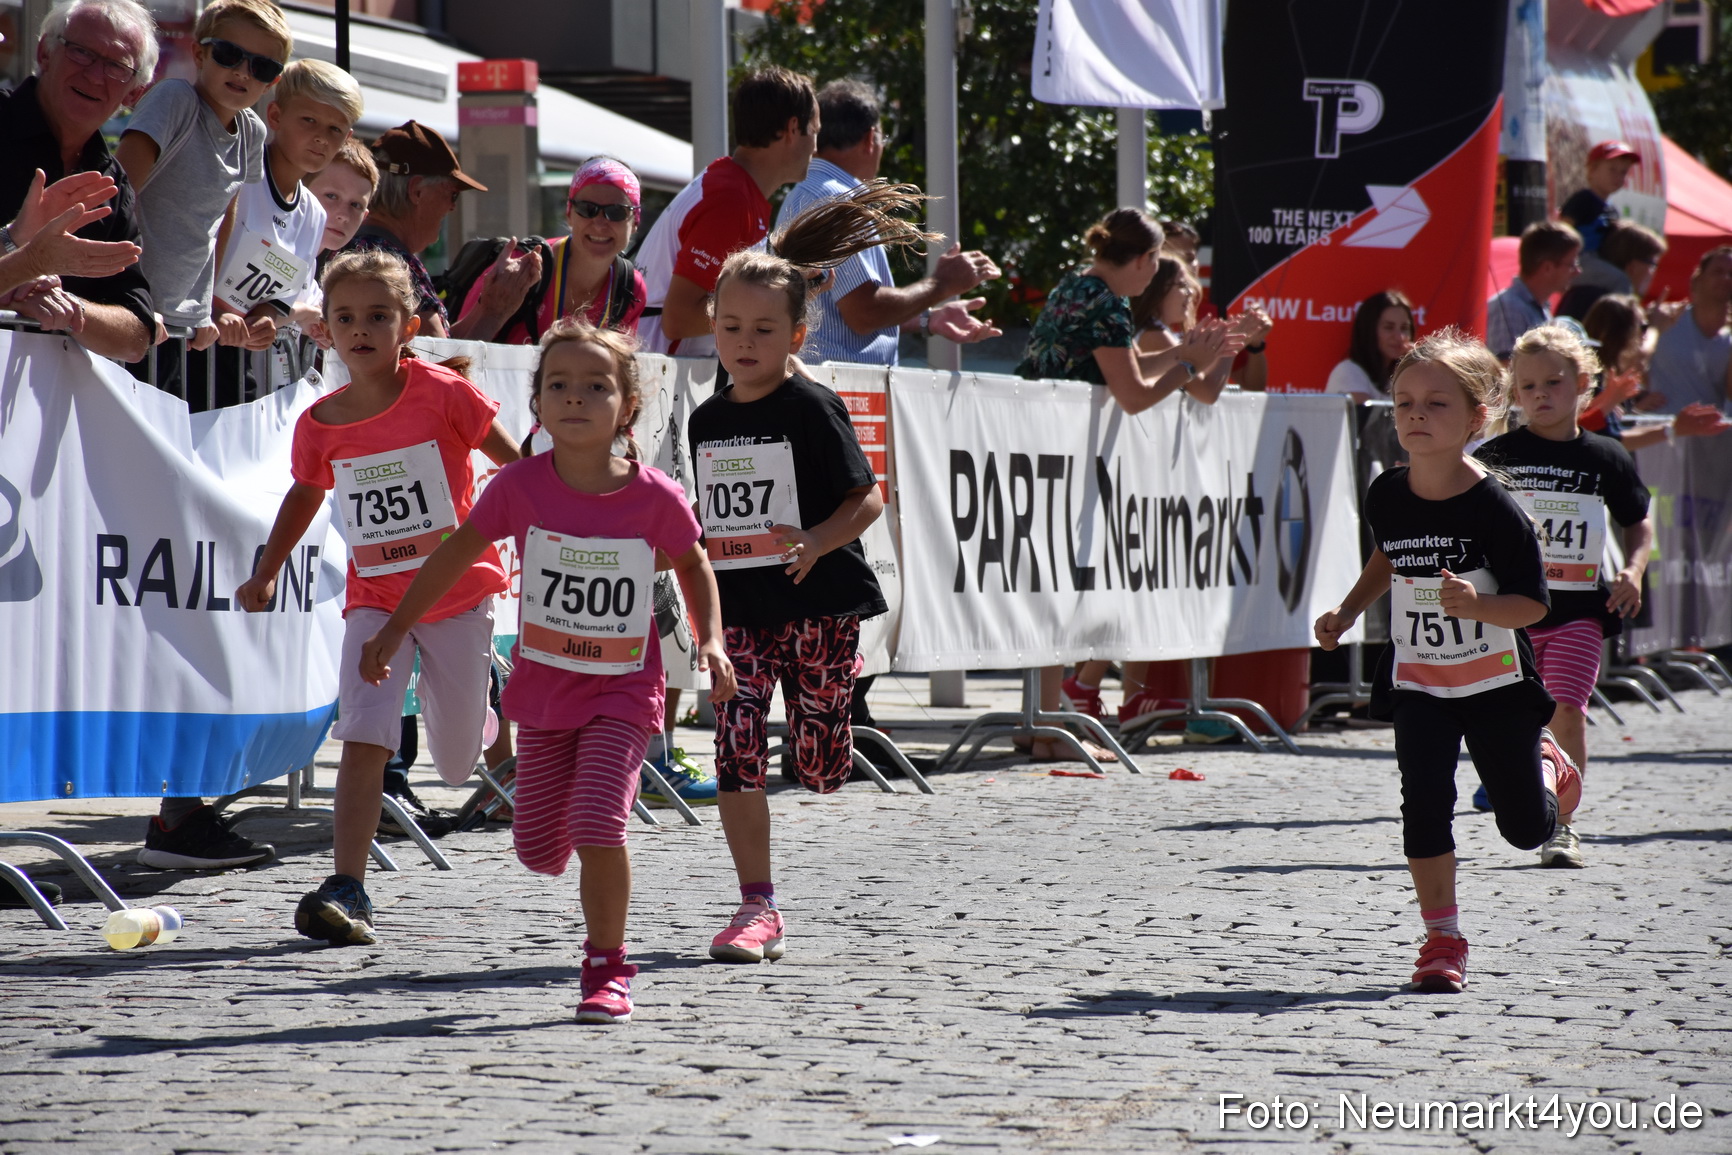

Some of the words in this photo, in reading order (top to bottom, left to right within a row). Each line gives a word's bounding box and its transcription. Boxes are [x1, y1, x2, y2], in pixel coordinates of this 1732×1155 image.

[1273, 209, 1304, 227] THE
[1309, 211, 1355, 229] NEXT
[1248, 227, 1272, 244] 100
[1275, 228, 1331, 246] YEARS
[264, 251, 298, 279] BOCK
[691, 246, 712, 261] Laufen
[711, 256, 721, 267] für
[694, 258, 707, 270] Rosi
[235, 262, 285, 301] 705
[228, 294, 245, 307] PARTL
[699, 435, 757, 449] eumarkter
[354, 461, 406, 481] BOCK
[712, 457, 755, 472] BOCK
[1511, 478, 1559, 491] adtlauf
[348, 480, 429, 528] 7351
[706, 479, 775, 519] 7037
[1534, 499, 1580, 512] BOCK
[726, 523, 761, 532] Neumarkt
[950, 449, 1095, 593] PARTL
[1096, 455, 1265, 593] Neumarkt
[362, 530, 384, 539] PARTL
[385, 523, 421, 536] Neumarkt
[1537, 518, 1588, 549] 441
[381, 544, 417, 561] Lena
[722, 541, 752, 556] Lisa
[1383, 535, 1454, 553] Neumarkter
[560, 547, 619, 565] BOCK
[1390, 553, 1440, 568] adtlauf
[1546, 565, 1563, 578] isa
[526, 595, 534, 603] B1
[541, 568, 635, 617] 7500
[1414, 588, 1442, 601] BO
[546, 615, 571, 628] PARTL
[573, 621, 614, 632] Neumarkt
[562, 638, 602, 658] Julia
[1417, 652, 1440, 660] PARTL
[1440, 648, 1477, 660] Neumarkt
